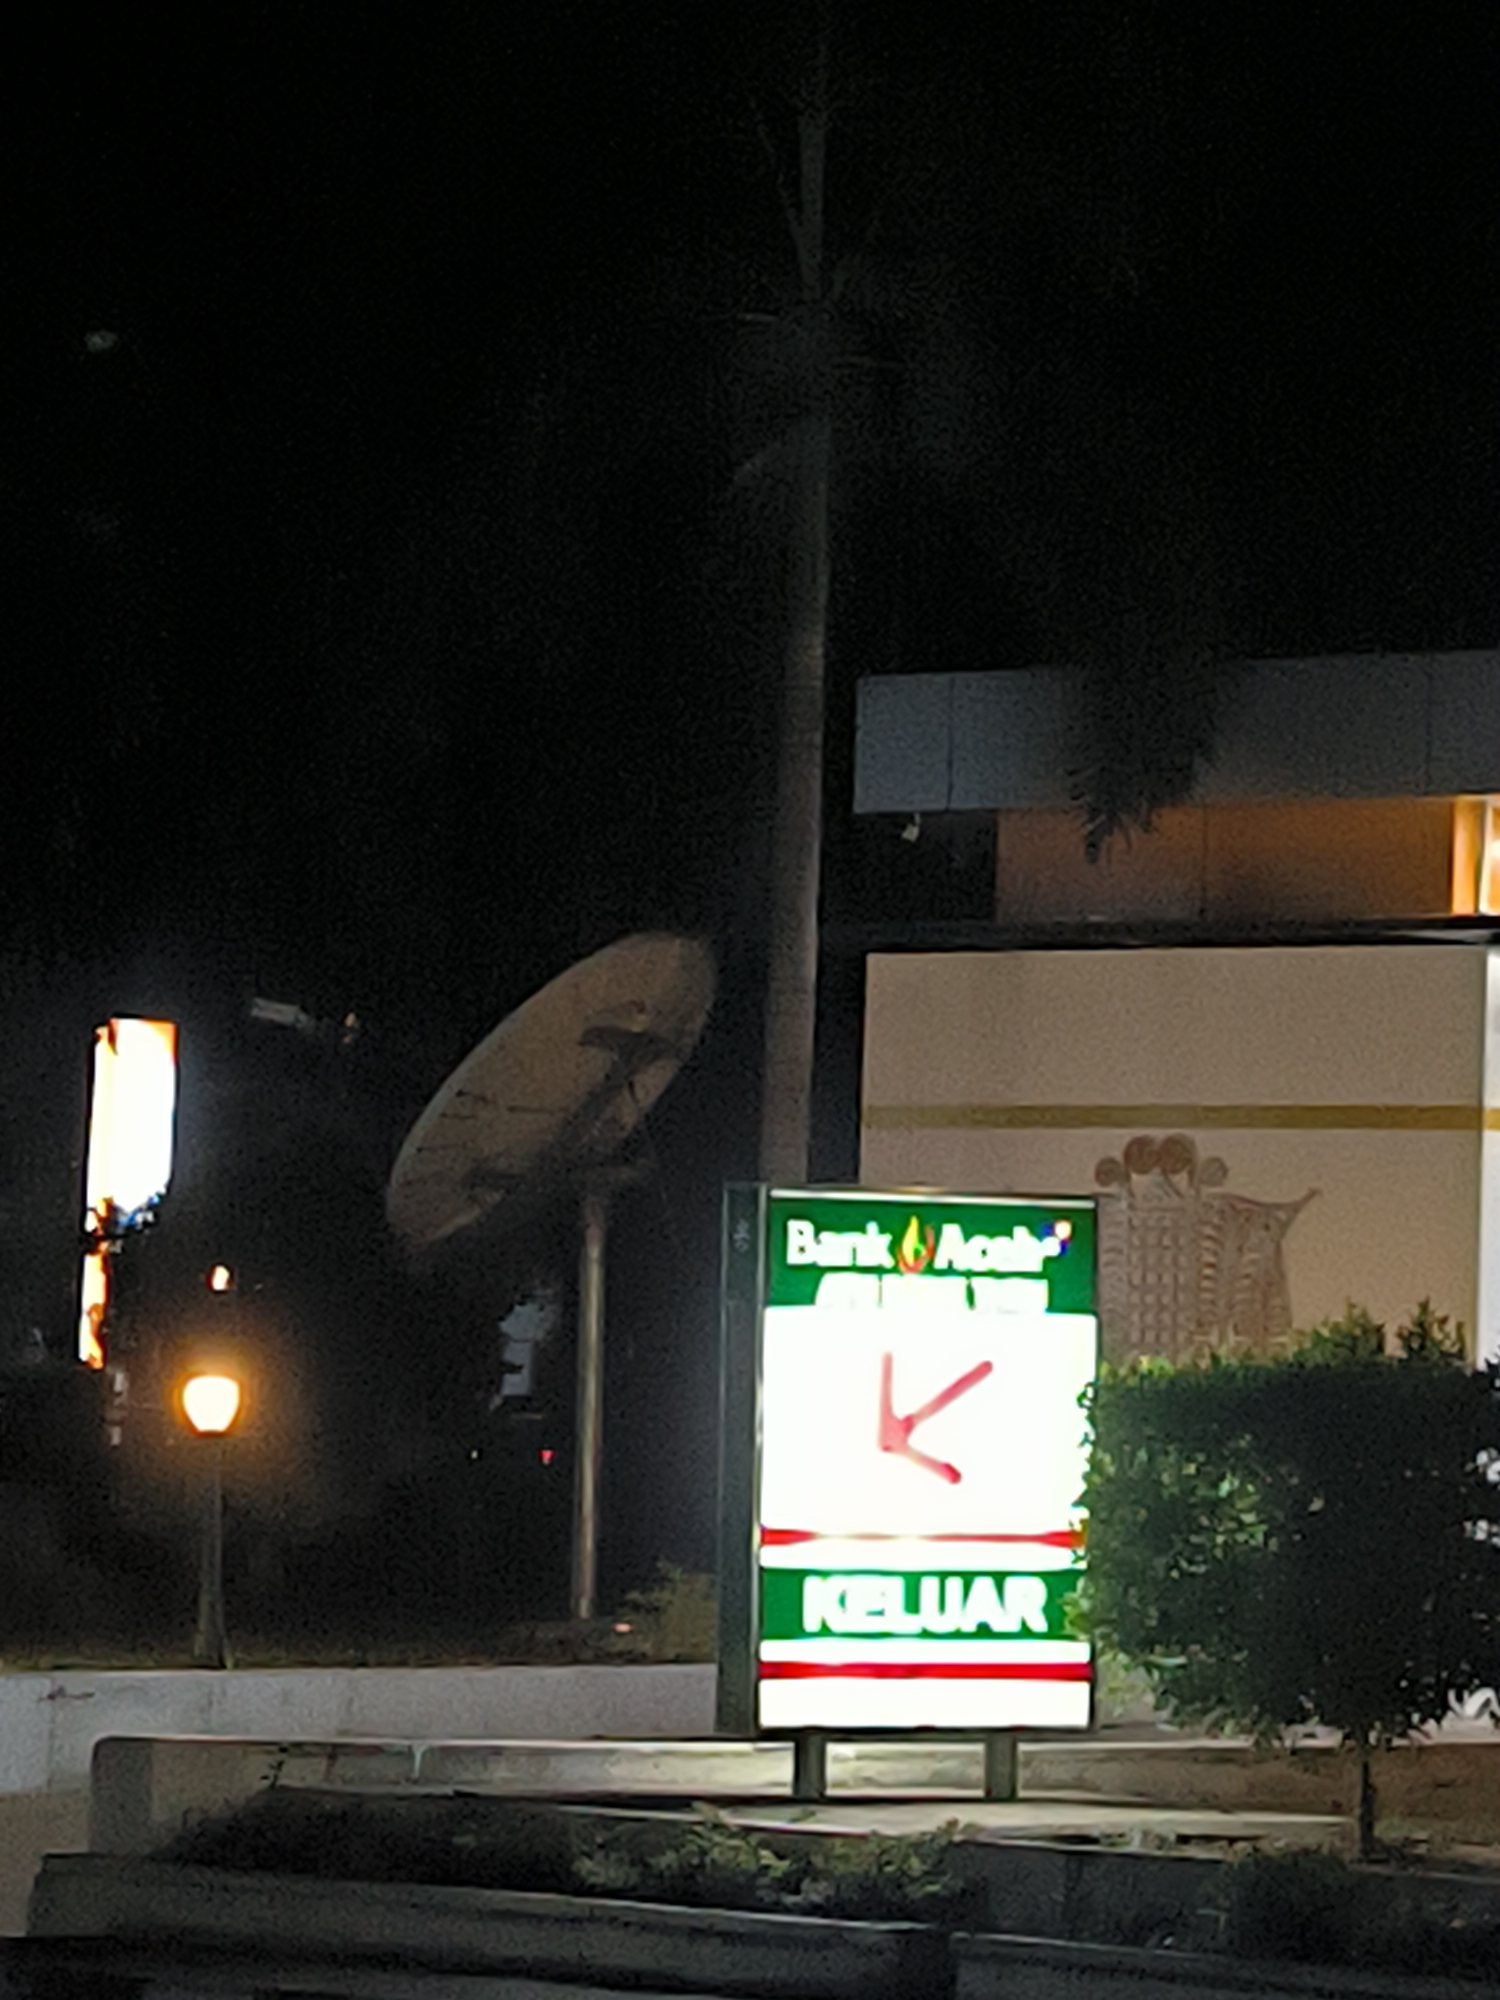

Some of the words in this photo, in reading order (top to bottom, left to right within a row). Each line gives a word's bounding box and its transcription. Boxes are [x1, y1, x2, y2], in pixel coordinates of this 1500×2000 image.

[786, 1219, 895, 1269] Bank
[933, 1223, 1045, 1272] Aceh
[803, 1575, 1048, 1634] KELUAR
